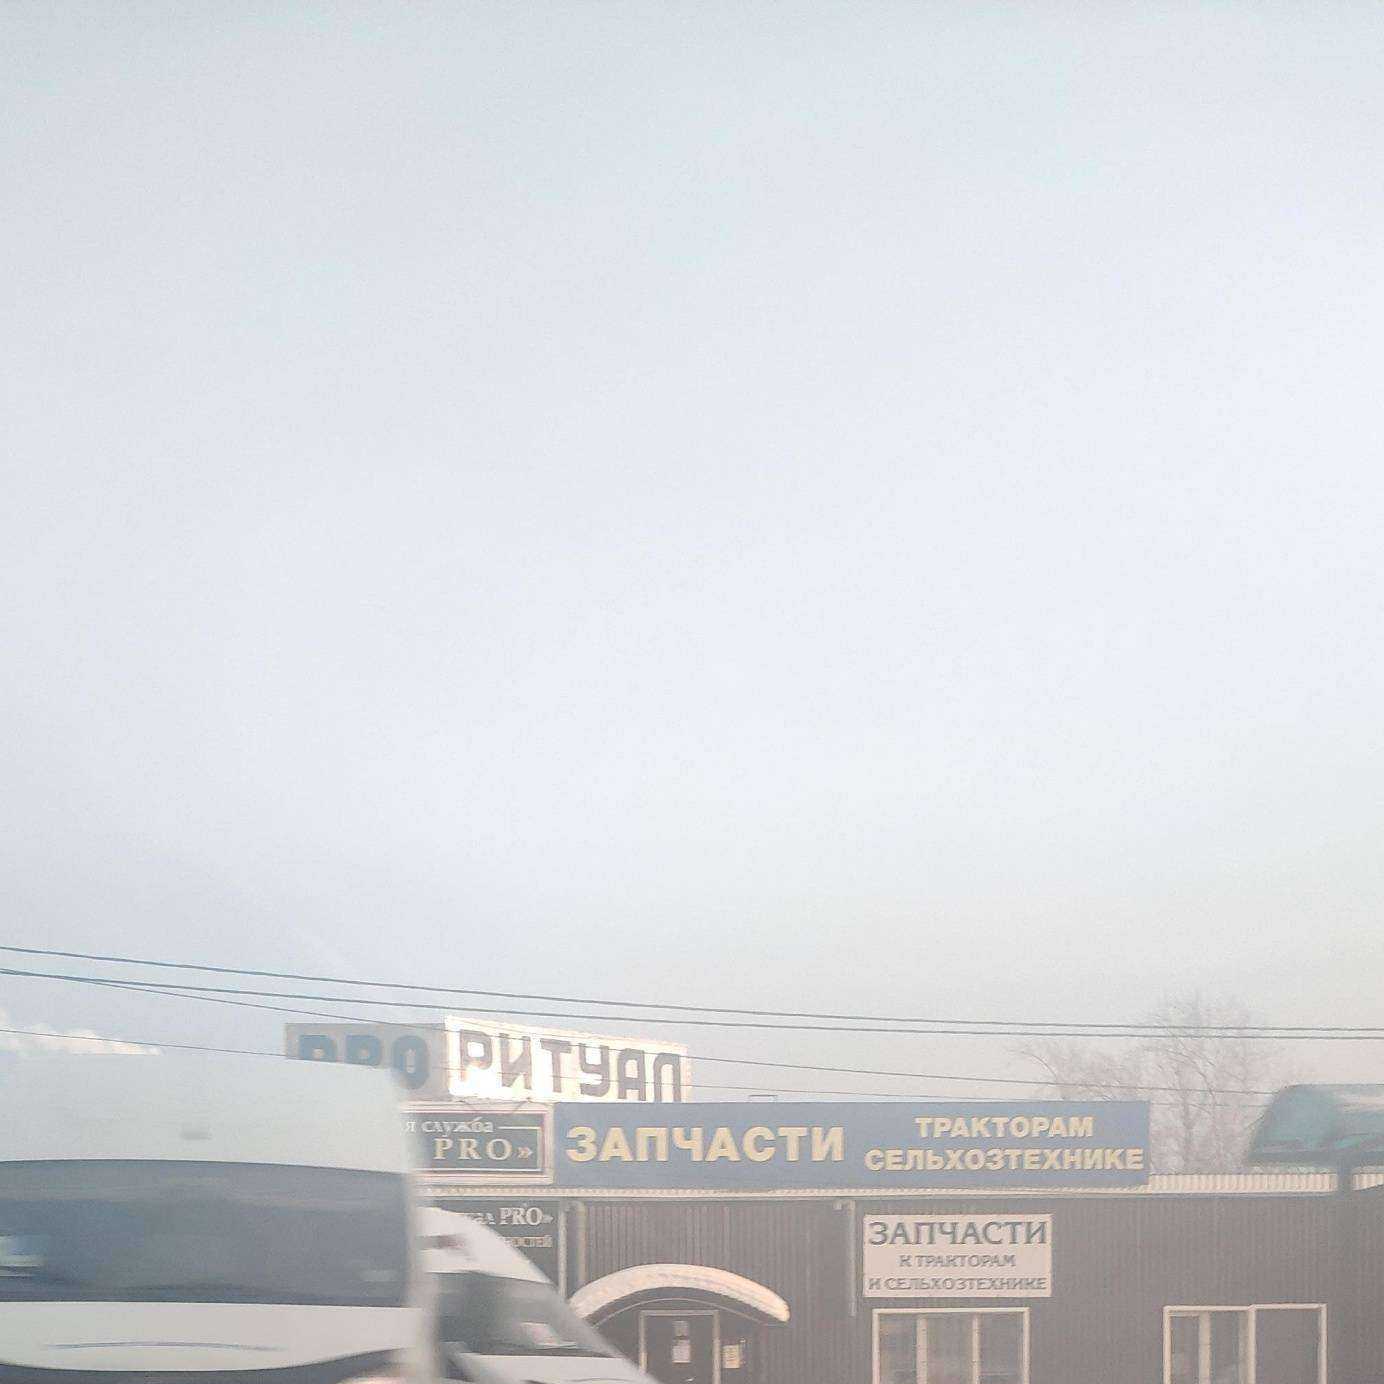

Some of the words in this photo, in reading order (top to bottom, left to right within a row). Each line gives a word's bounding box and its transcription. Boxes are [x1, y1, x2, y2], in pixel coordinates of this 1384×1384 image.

[459, 1029, 682, 1102] РИТУАЛ
[421, 1117, 494, 1137] служба
[915, 1117, 1094, 1138] ТРАКТОРАМ
[433, 1138, 533, 1161] PRO»
[566, 1126, 845, 1162] ЗАПЧАСТИ
[864, 1148, 1145, 1171] СЕЛЬХОЗТЕХНИКЕ
[868, 1221, 1048, 1246] ЗАПЧАСТИ
[899, 1255, 913, 1268] К
[915, 1254, 1017, 1268] ТРАКТОРАМ
[868, 1278, 882, 1291] И
[884, 1277, 1048, 1291] СЕЛЬХОЗТЕХНИКЕ
